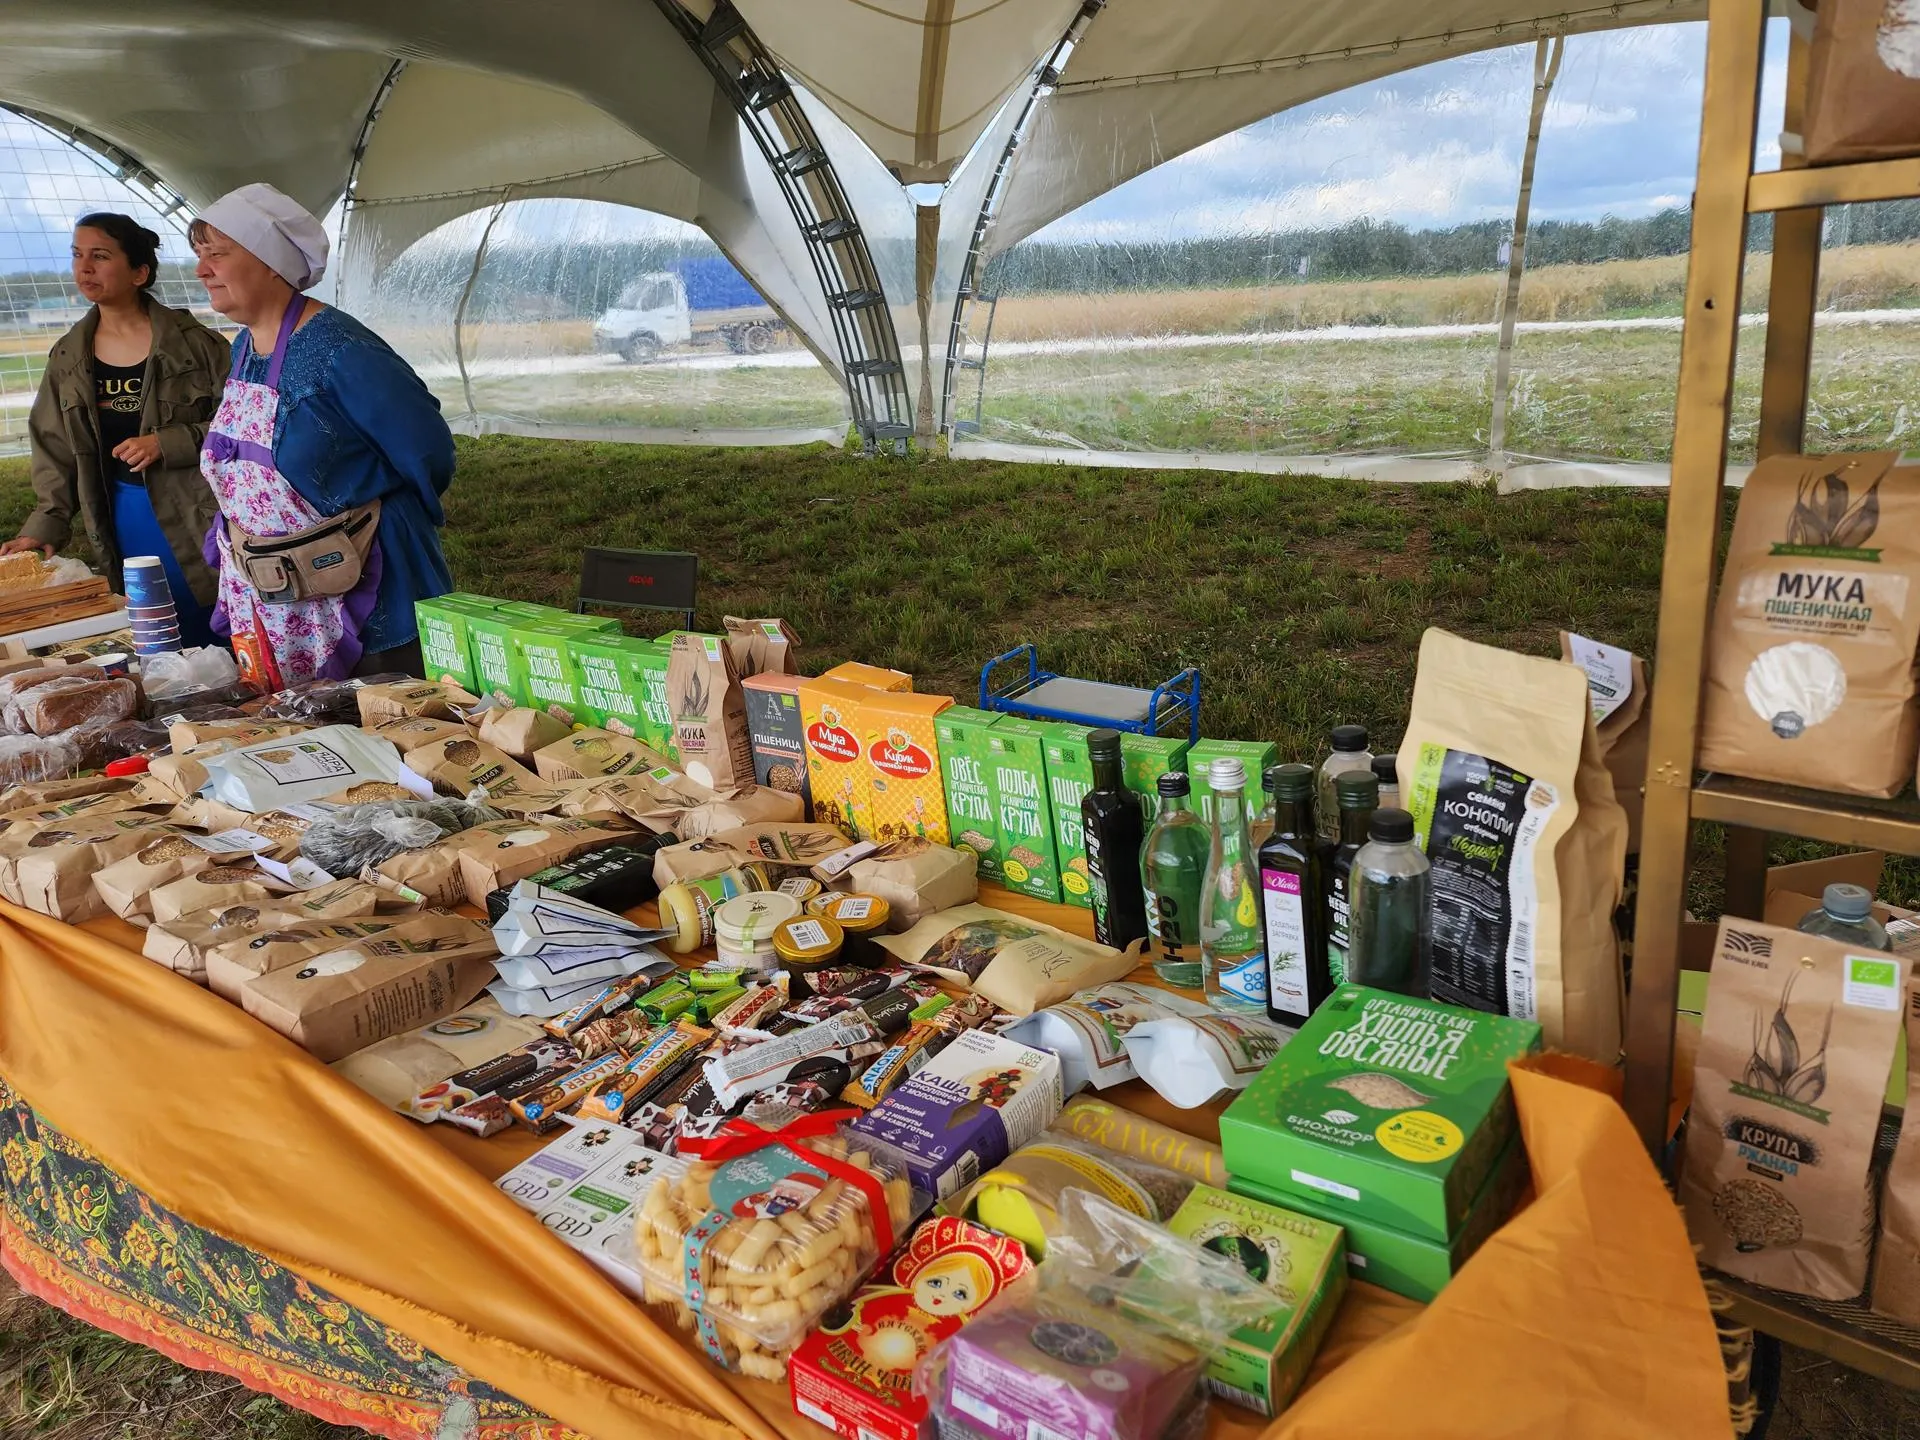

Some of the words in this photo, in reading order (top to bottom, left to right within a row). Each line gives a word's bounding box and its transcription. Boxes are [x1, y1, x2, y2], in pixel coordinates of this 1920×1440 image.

[1777, 572, 1864, 604] МУКА
[1765, 599, 1873, 622] ПШЕНИЧНАЯ
[427, 626, 456, 654] ХЛОПЬЯ
[478, 640, 507, 667] ХЛОПЬЯ
[527, 655, 563, 680] ХЛОПЬЯ
[583, 666, 622, 692] ХЛОПЬЯ
[529, 677, 576, 704] ПОЛБЯНЫЕ
[580, 686, 639, 716] СПЕЛЬТОВЫЕ
[647, 681, 668, 703] ХЛО
[642, 700, 672, 724] ЧЕЧЕВ
[680, 727, 706, 740] МУКА
[754, 733, 802, 751] ПШЕНИЦА
[818, 726, 846, 746] Мука
[820, 742, 837, 753] мякоти
[883, 748, 915, 766] Кубик
[316, 751, 345, 772] ЯДРА
[606, 754, 631, 774] КРУПА
[949, 755, 984, 785] ОВЁС
[477, 767, 501, 786] КРУПА
[996, 767, 1040, 799] ПОЛБА
[951, 791, 993, 822] КРУПА
[1443, 800, 1514, 836] КОНОПЛИ
[1000, 806, 1044, 838] КРУПА
[1271, 876, 1299, 892] Olivia
[1270, 920, 1299, 931] САЛАТНАЯ
[1271, 930, 1299, 941] ЗАПРАВКА
[1364, 998, 1478, 1033] ОРГАНИЧЕСКИЕ
[966, 1038, 995, 1051] ПОЛЕЗНО
[1347, 1010, 1467, 1055] ХЛОПЬЯ
[638, 1033, 688, 1071] SNAQER
[1319, 1031, 1459, 1081] ОВСЯНЫЕ
[863, 1048, 902, 1092] SNAQER
[914, 1070, 972, 1095] КАША
[905, 1080, 965, 1103] КОНОПЛЯНАЯ
[907, 1088, 951, 1106] МОЛОКОМ
[890, 1112, 923, 1127] МИНУТЫ
[892, 1102, 926, 1117] ПОРЦИЙ
[884, 1117, 907, 1129] КАША
[906, 1124, 934, 1140] ГОТОВА
[1286, 1114, 1375, 1142] БИОХУТОР
[1291, 1125, 1355, 1148] ПЕТРОВСКИЙ
[1403, 1127, 1430, 1142] БЕЗ
[1073, 1112, 1213, 1181] GRANOLA
[1741, 1126, 1801, 1160] КРУПА
[1737, 1144, 1799, 1177] РЖАНАЯ
[500, 1177, 550, 1202] CBD
[541, 1211, 593, 1238] CBD
